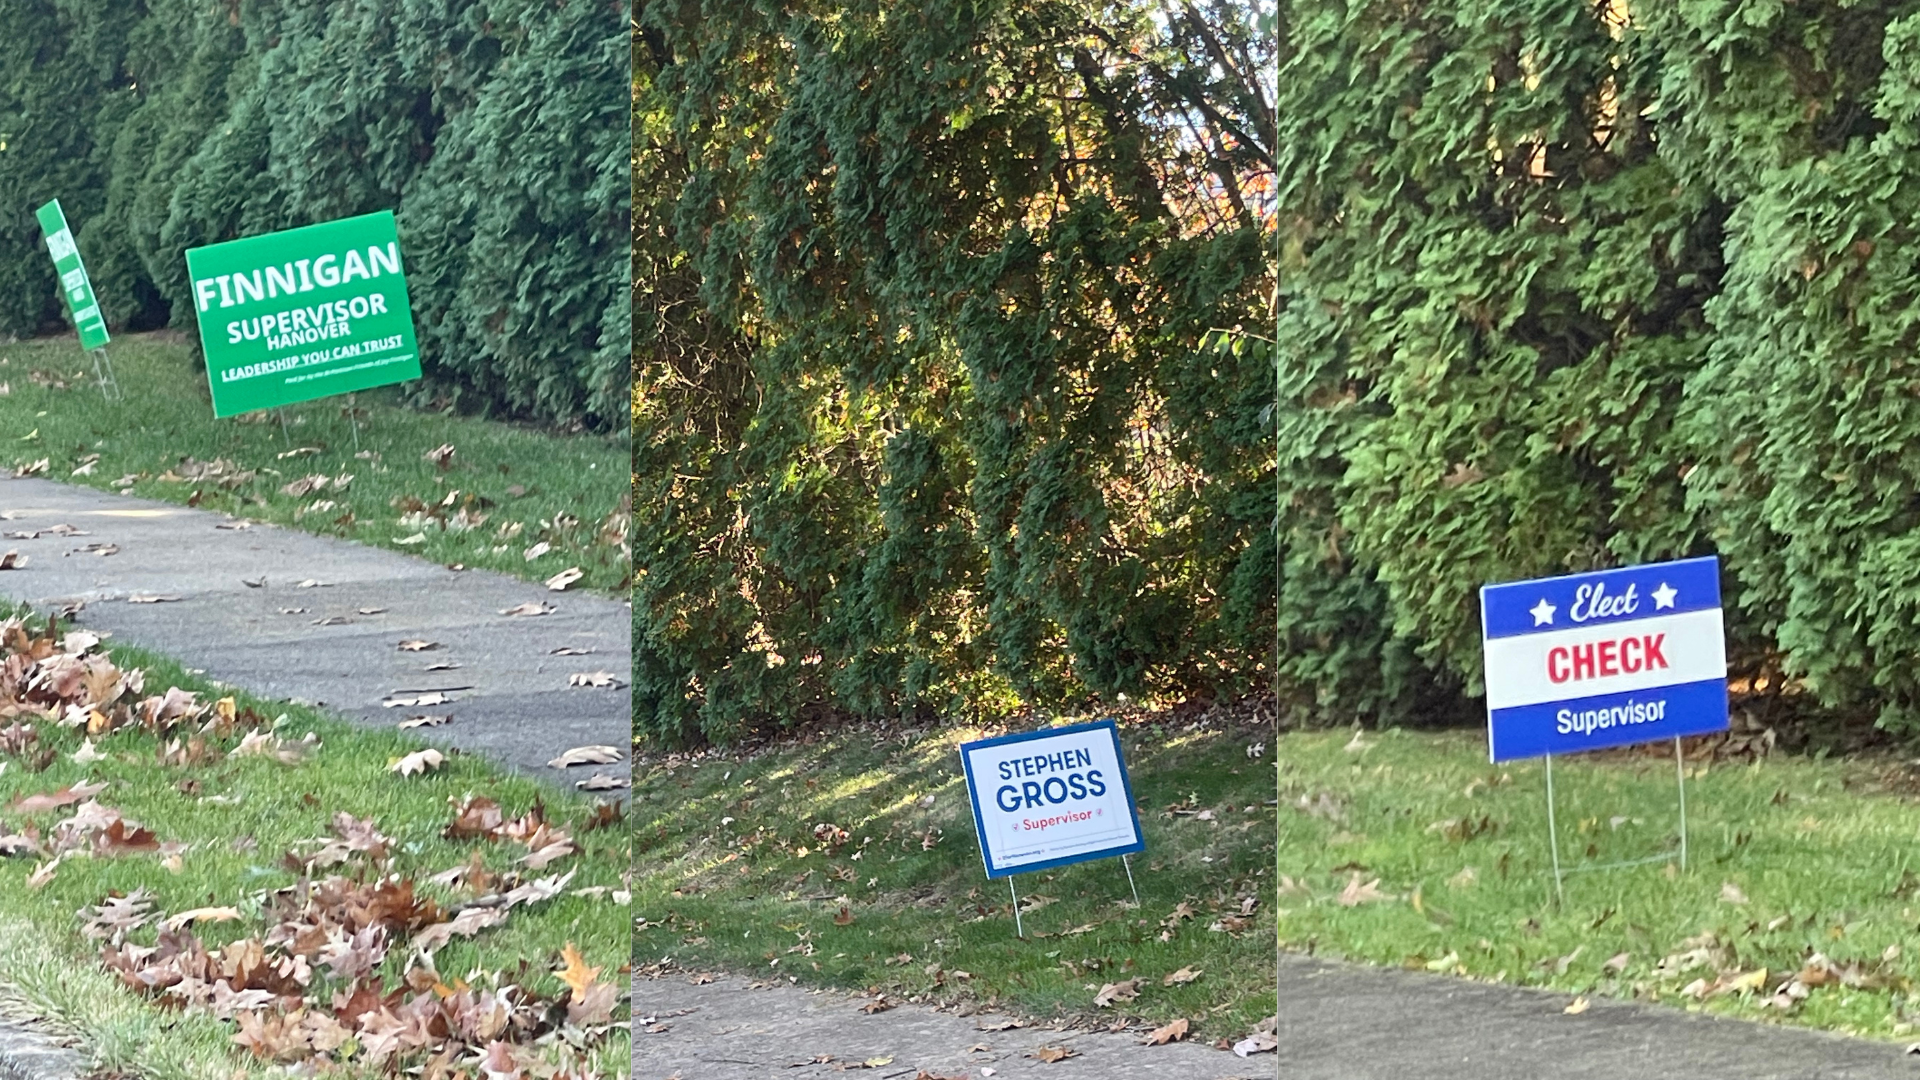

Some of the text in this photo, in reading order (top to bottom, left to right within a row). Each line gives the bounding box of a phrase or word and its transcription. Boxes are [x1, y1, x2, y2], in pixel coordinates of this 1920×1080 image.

[196, 242, 400, 312] FINNIGAN
[226, 293, 388, 344] SUPERVISOR
[266, 321, 351, 350] HANOVER
[221, 355, 300, 382] LEADERSHIP
[302, 349, 330, 365] YOU
[332, 343, 361, 358] CAN
[363, 334, 404, 352] TRUST
[1570, 582, 1639, 622] Elect
[1548, 633, 1669, 684] CHECK
[1557, 699, 1667, 735] Supervisor
[998, 748, 1092, 780] STEPHEN
[996, 770, 1107, 813] GROSS
[1023, 810, 1093, 831] Supervisor
